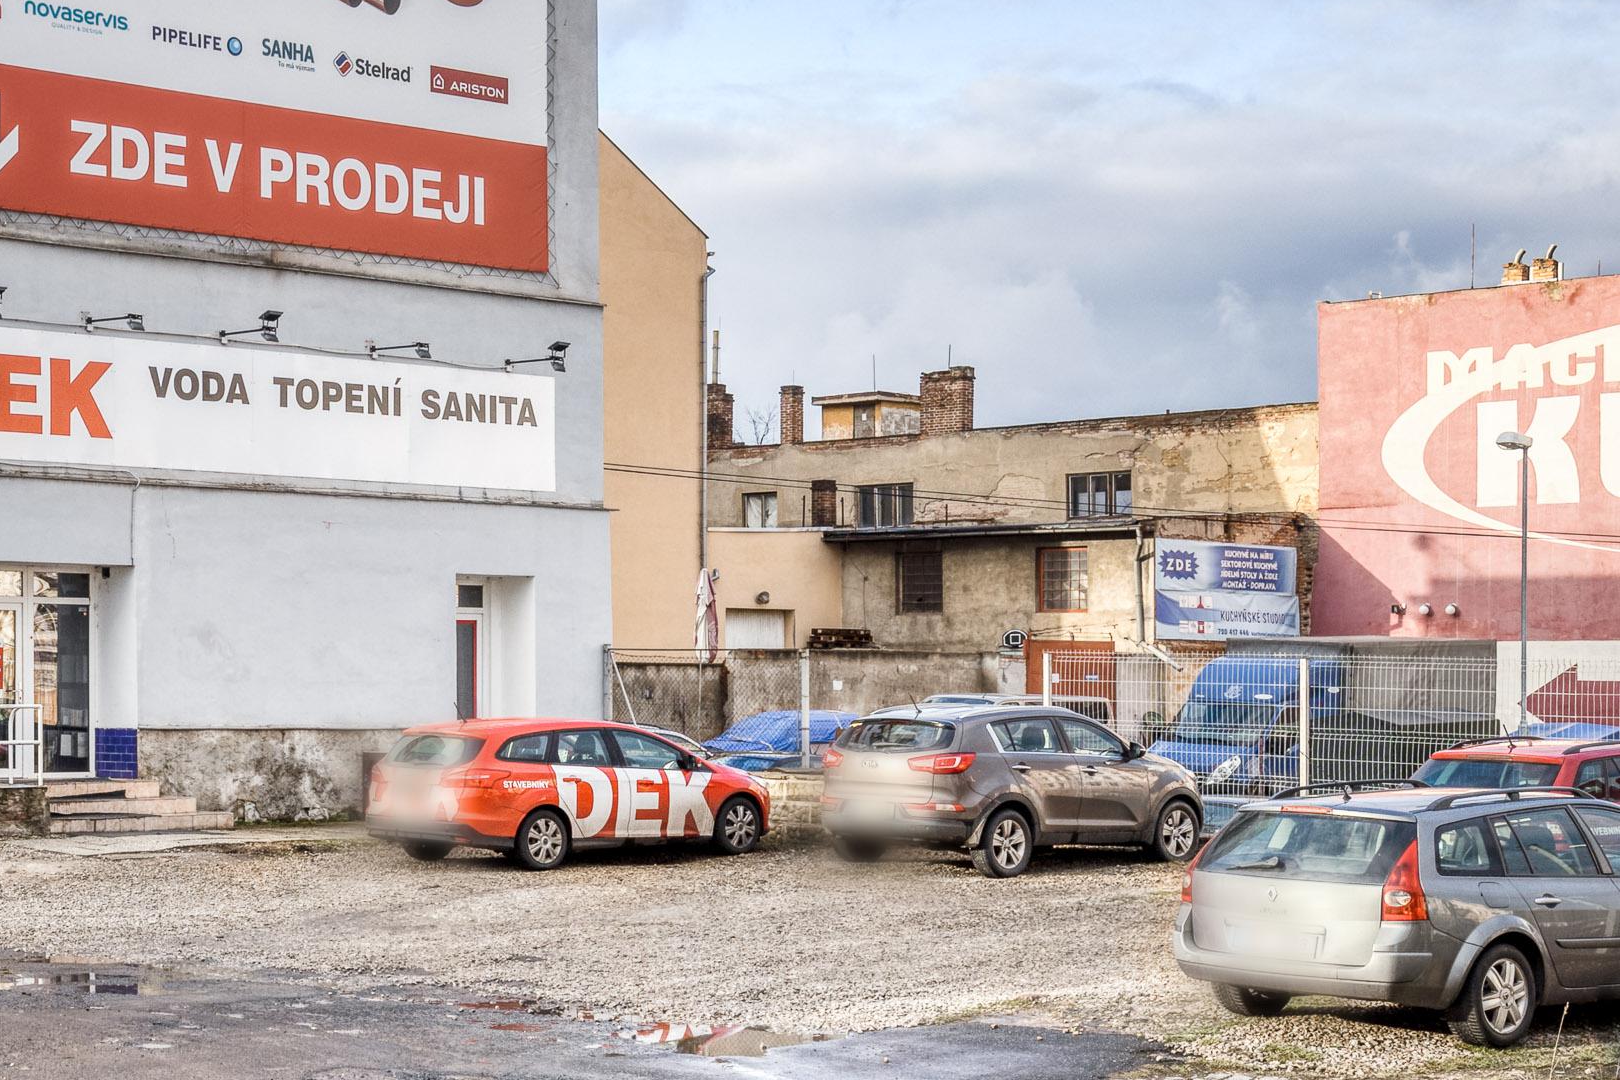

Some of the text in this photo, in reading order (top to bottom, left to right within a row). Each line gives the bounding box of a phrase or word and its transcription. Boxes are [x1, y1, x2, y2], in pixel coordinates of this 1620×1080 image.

[24, 0, 129, 31] novaservis
[52, 22, 75, 31] QUALITY
[82, 26, 103, 35] DESIGN
[152, 26, 222, 51] PIPELIFE
[262, 38, 315, 63] SANHA
[355, 58, 411, 83] Stelrad
[450, 81, 505, 99] ARISTON
[70, 119, 486, 226] ZDE V PRODEJI
[148, 365, 250, 405] VODA
[272, 376, 402, 417] TOPENÍ
[420, 388, 538, 427] SANITA
[1250, 551, 1259, 559] NA
[1260, 550, 1274, 560] MÍRU
[1166, 558, 1192, 572] ZDE
[1220, 559, 1253, 569] SEKTOROVÉ
[1241, 570, 1257, 579] STOLY
[1258, 572, 1263, 580] A
[1264, 570, 1278, 580] ŽIDLE
[1221, 579, 1246, 589] MONTÁŽ
[1250, 582, 1276, 591] DOPRAVA
[1220, 609, 1286, 625] KUCHYŇSKÉ STUDIO
[503, 780, 550, 789] STAVEBNINY
[551, 764, 715, 838] DEK
